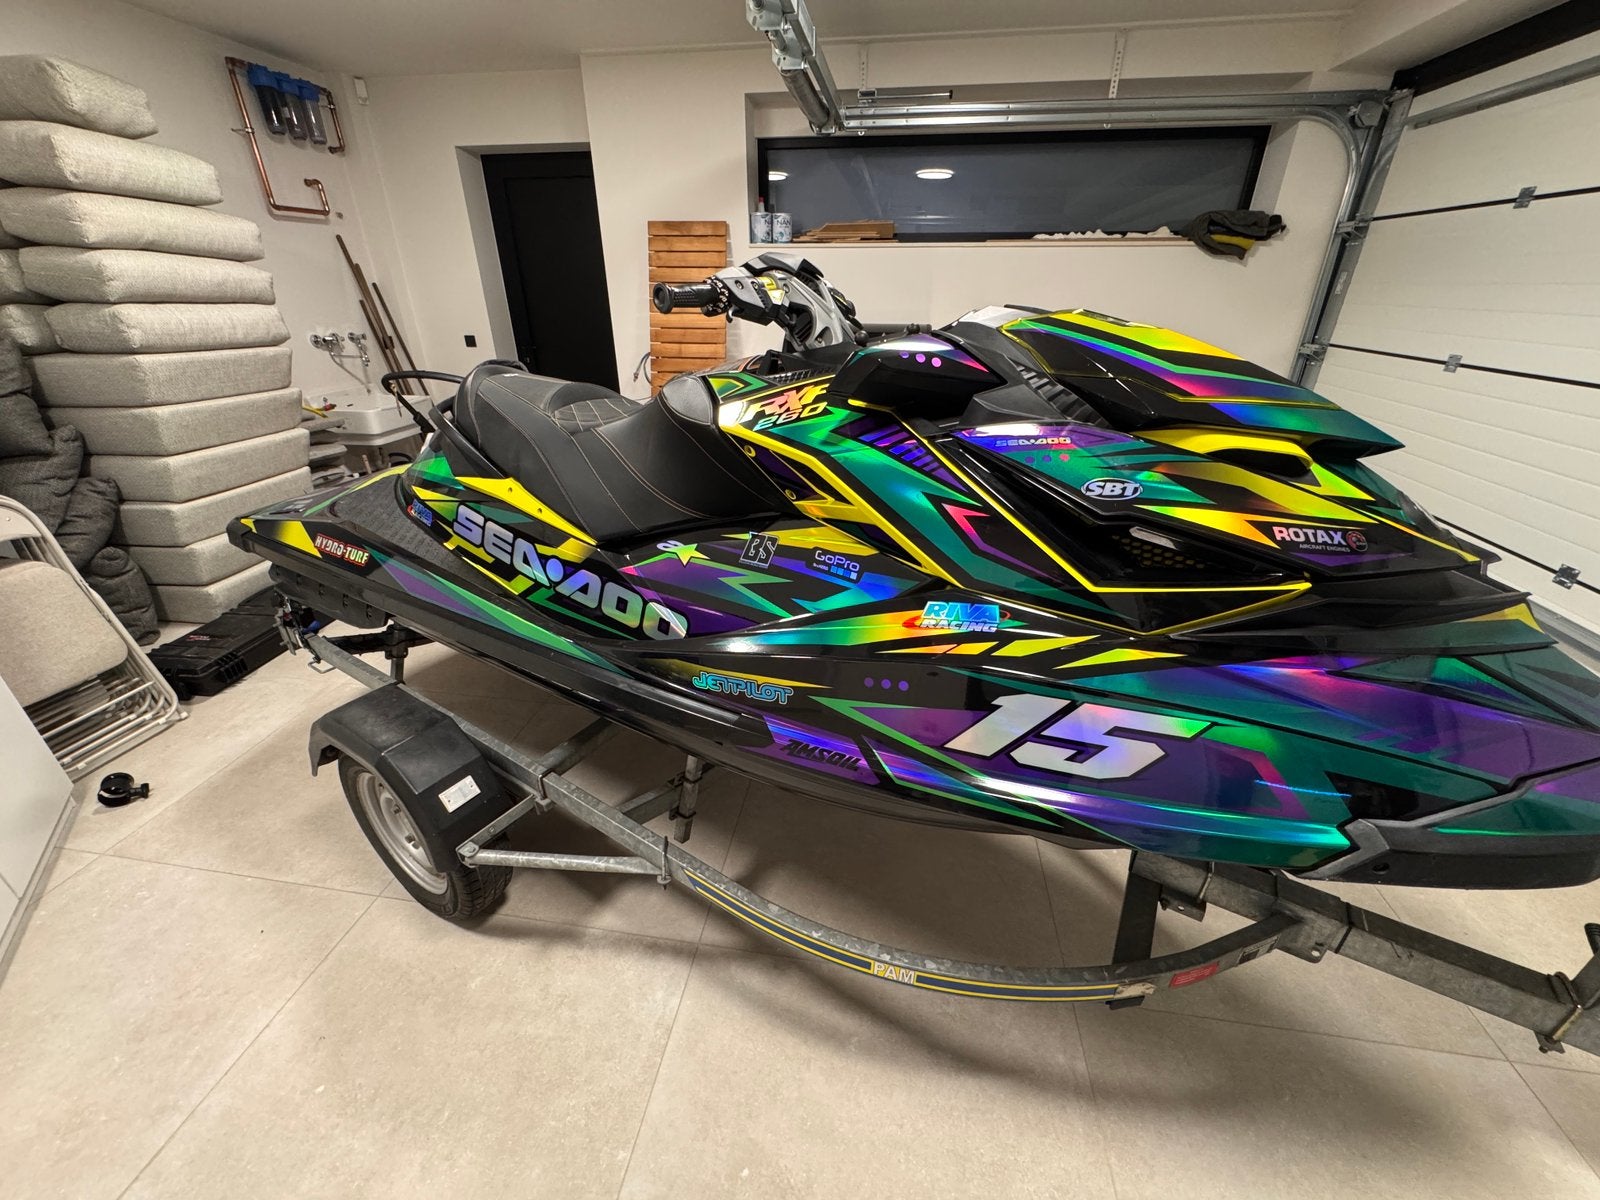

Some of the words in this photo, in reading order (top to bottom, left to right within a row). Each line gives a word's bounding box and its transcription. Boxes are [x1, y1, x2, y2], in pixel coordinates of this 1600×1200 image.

[753, 402, 828, 431] 260
[1085, 482, 1141, 497] SBT
[1272, 526, 1348, 546] ROTAX
[314, 535, 370, 565] HYDRO-TURF
[1299, 543, 1327, 551] AIRCRAFT
[1327, 545, 1351, 553] ENGINES
[814, 550, 860, 572] GoPro
[921, 601, 1000, 623] RIVA
[920, 619, 998, 633] RACING
[692, 672, 794, 705] JETPILOT
[943, 693, 1212, 780] 15
[780, 738, 864, 773] AMSOIL
[873, 961, 915, 985] PAM
